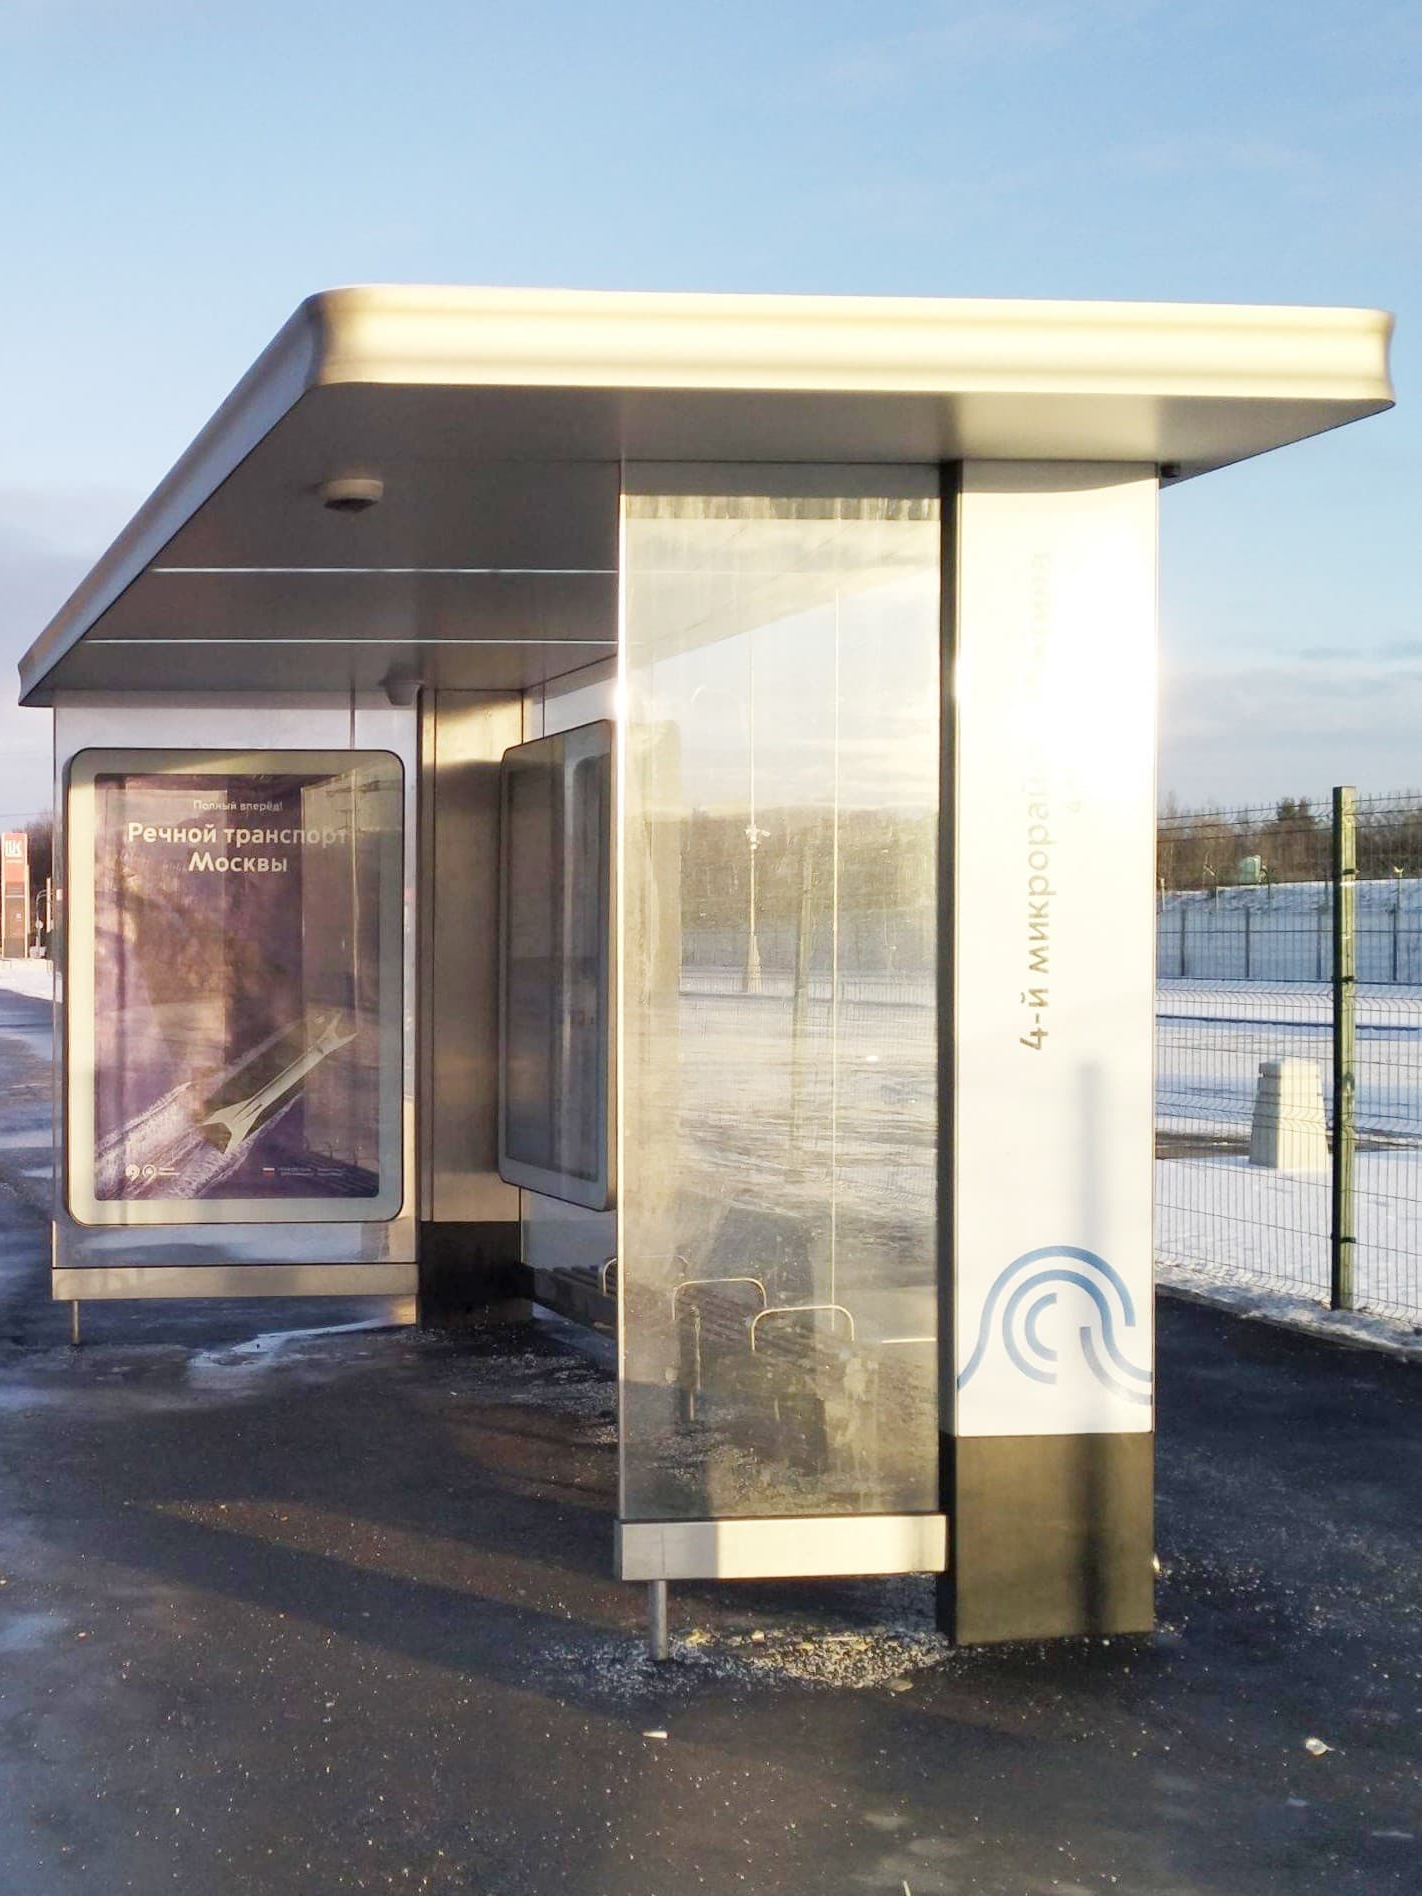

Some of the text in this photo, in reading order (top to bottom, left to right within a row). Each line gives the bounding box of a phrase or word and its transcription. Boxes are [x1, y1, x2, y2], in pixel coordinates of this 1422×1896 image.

[193, 799, 283, 812] Полный вперёд!
[128, 822, 348, 848] Речной транспорт
[188, 852, 289, 873] Москвы
[1018, 987, 1050, 1052] 4-й
